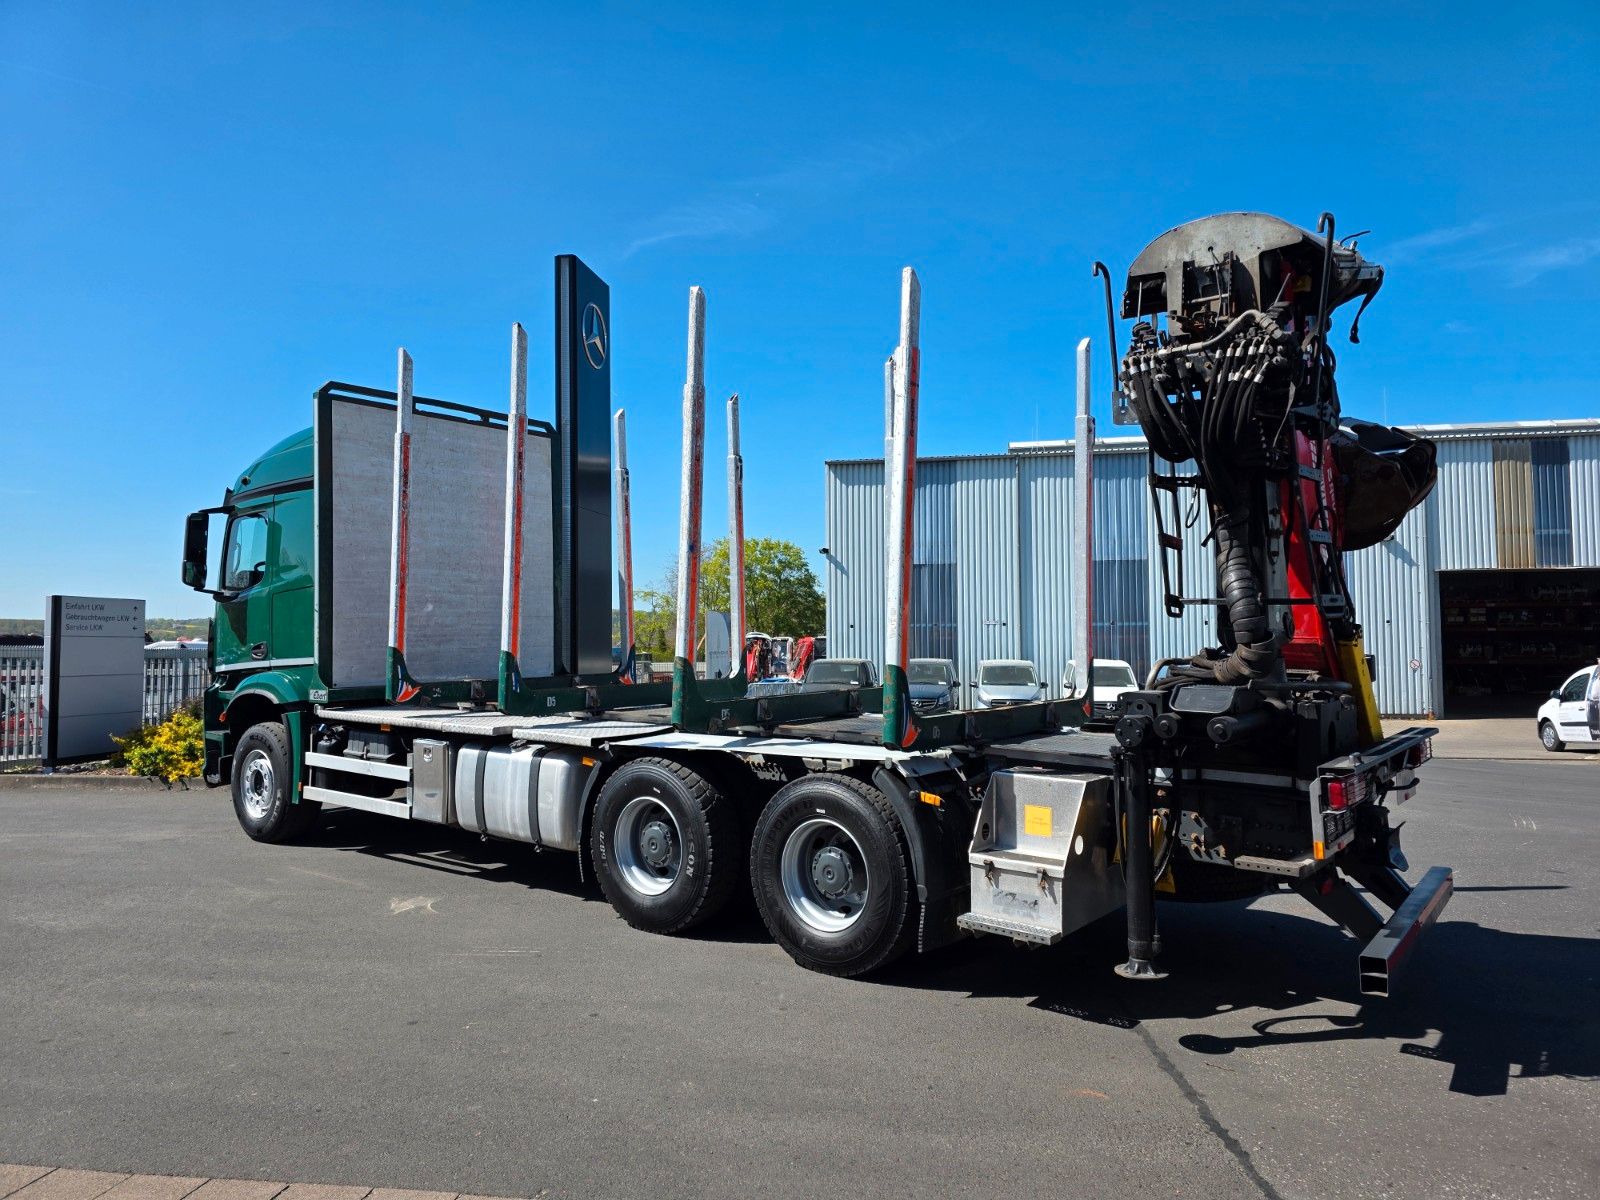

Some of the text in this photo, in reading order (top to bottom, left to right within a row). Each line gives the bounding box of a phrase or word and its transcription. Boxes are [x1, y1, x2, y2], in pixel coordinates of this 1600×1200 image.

[65, 602, 105, 611] Einfahrt LKW
[65, 613, 116, 623] Gebrauchtwagen
